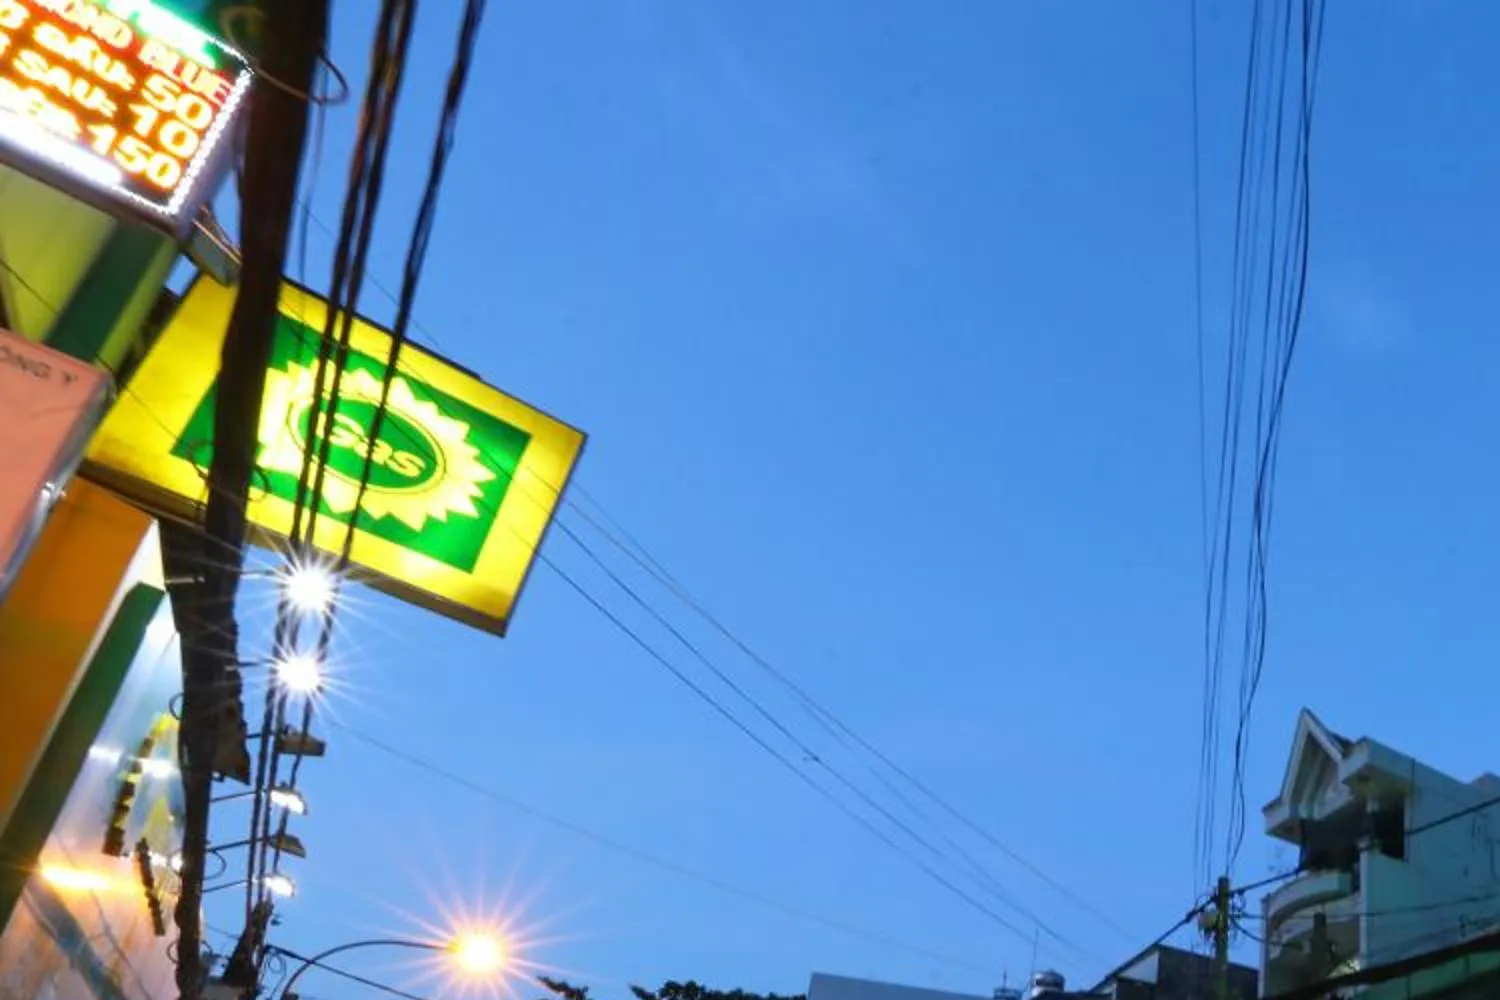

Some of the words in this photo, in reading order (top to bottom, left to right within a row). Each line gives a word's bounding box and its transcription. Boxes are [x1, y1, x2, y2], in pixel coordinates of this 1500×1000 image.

[128, 102, 200, 159] 10
[141, 73, 213, 130] 50
[87, 122, 182, 189] 150
[314, 411, 427, 478] Gas
